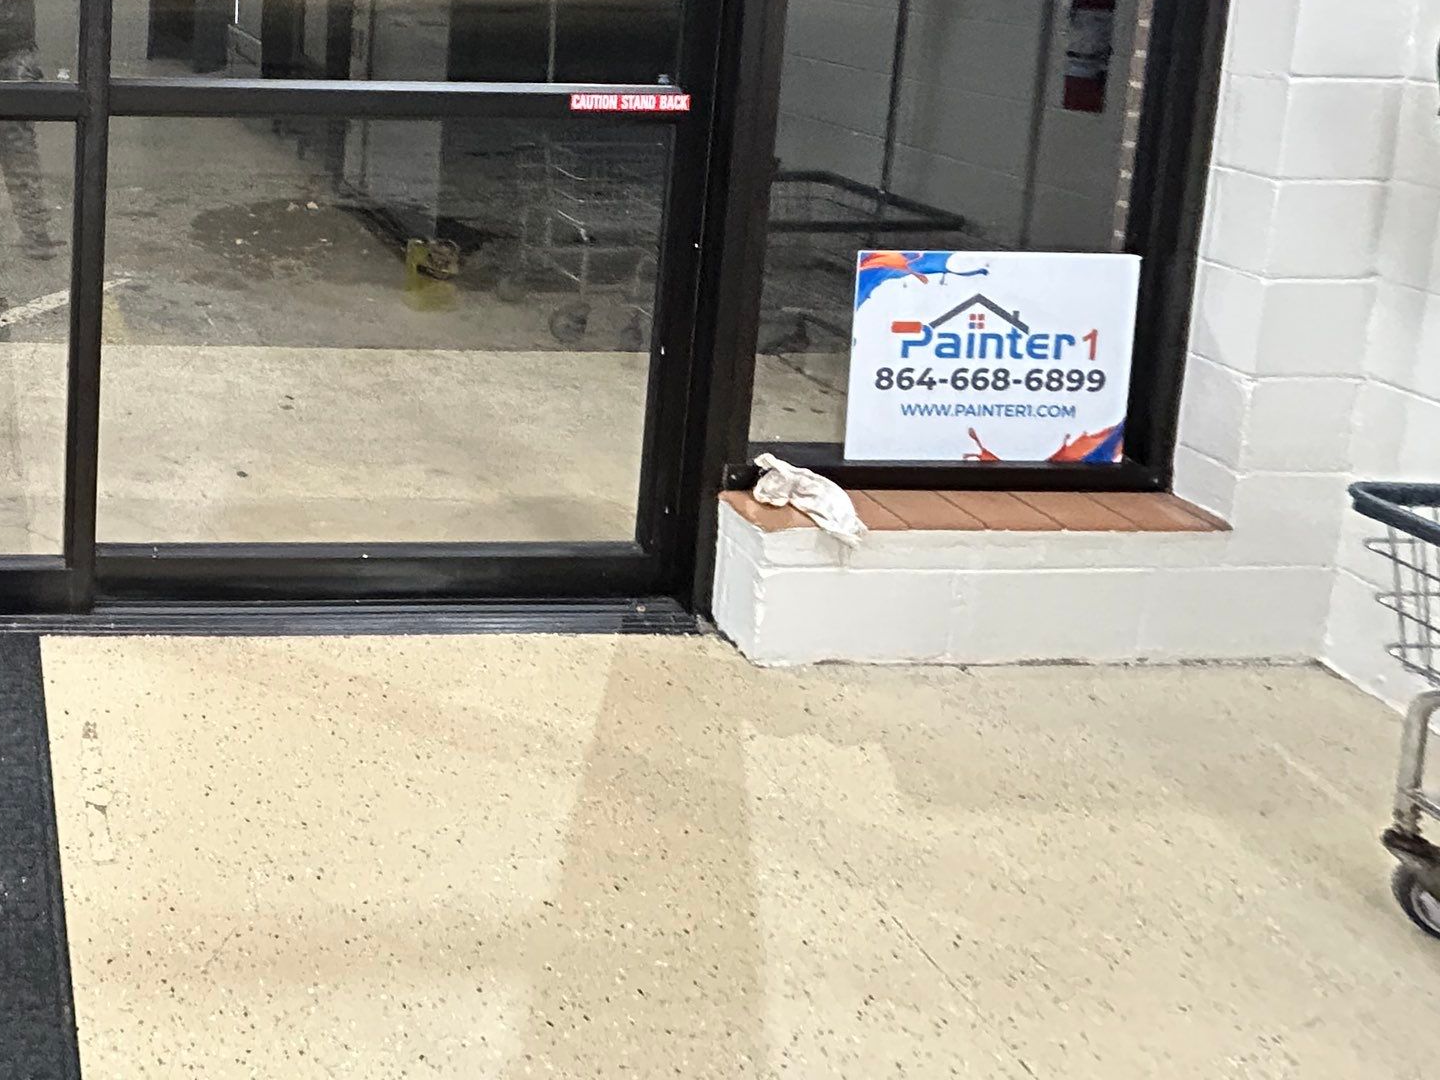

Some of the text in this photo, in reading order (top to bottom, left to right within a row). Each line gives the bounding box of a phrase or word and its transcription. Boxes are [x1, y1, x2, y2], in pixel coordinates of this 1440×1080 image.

[571, 94, 689, 110] CAUTION STAND BACK
[875, 367, 1106, 392] 864-668-6899
[901, 404, 1076, 418] WWW.PAINTER1.COM
